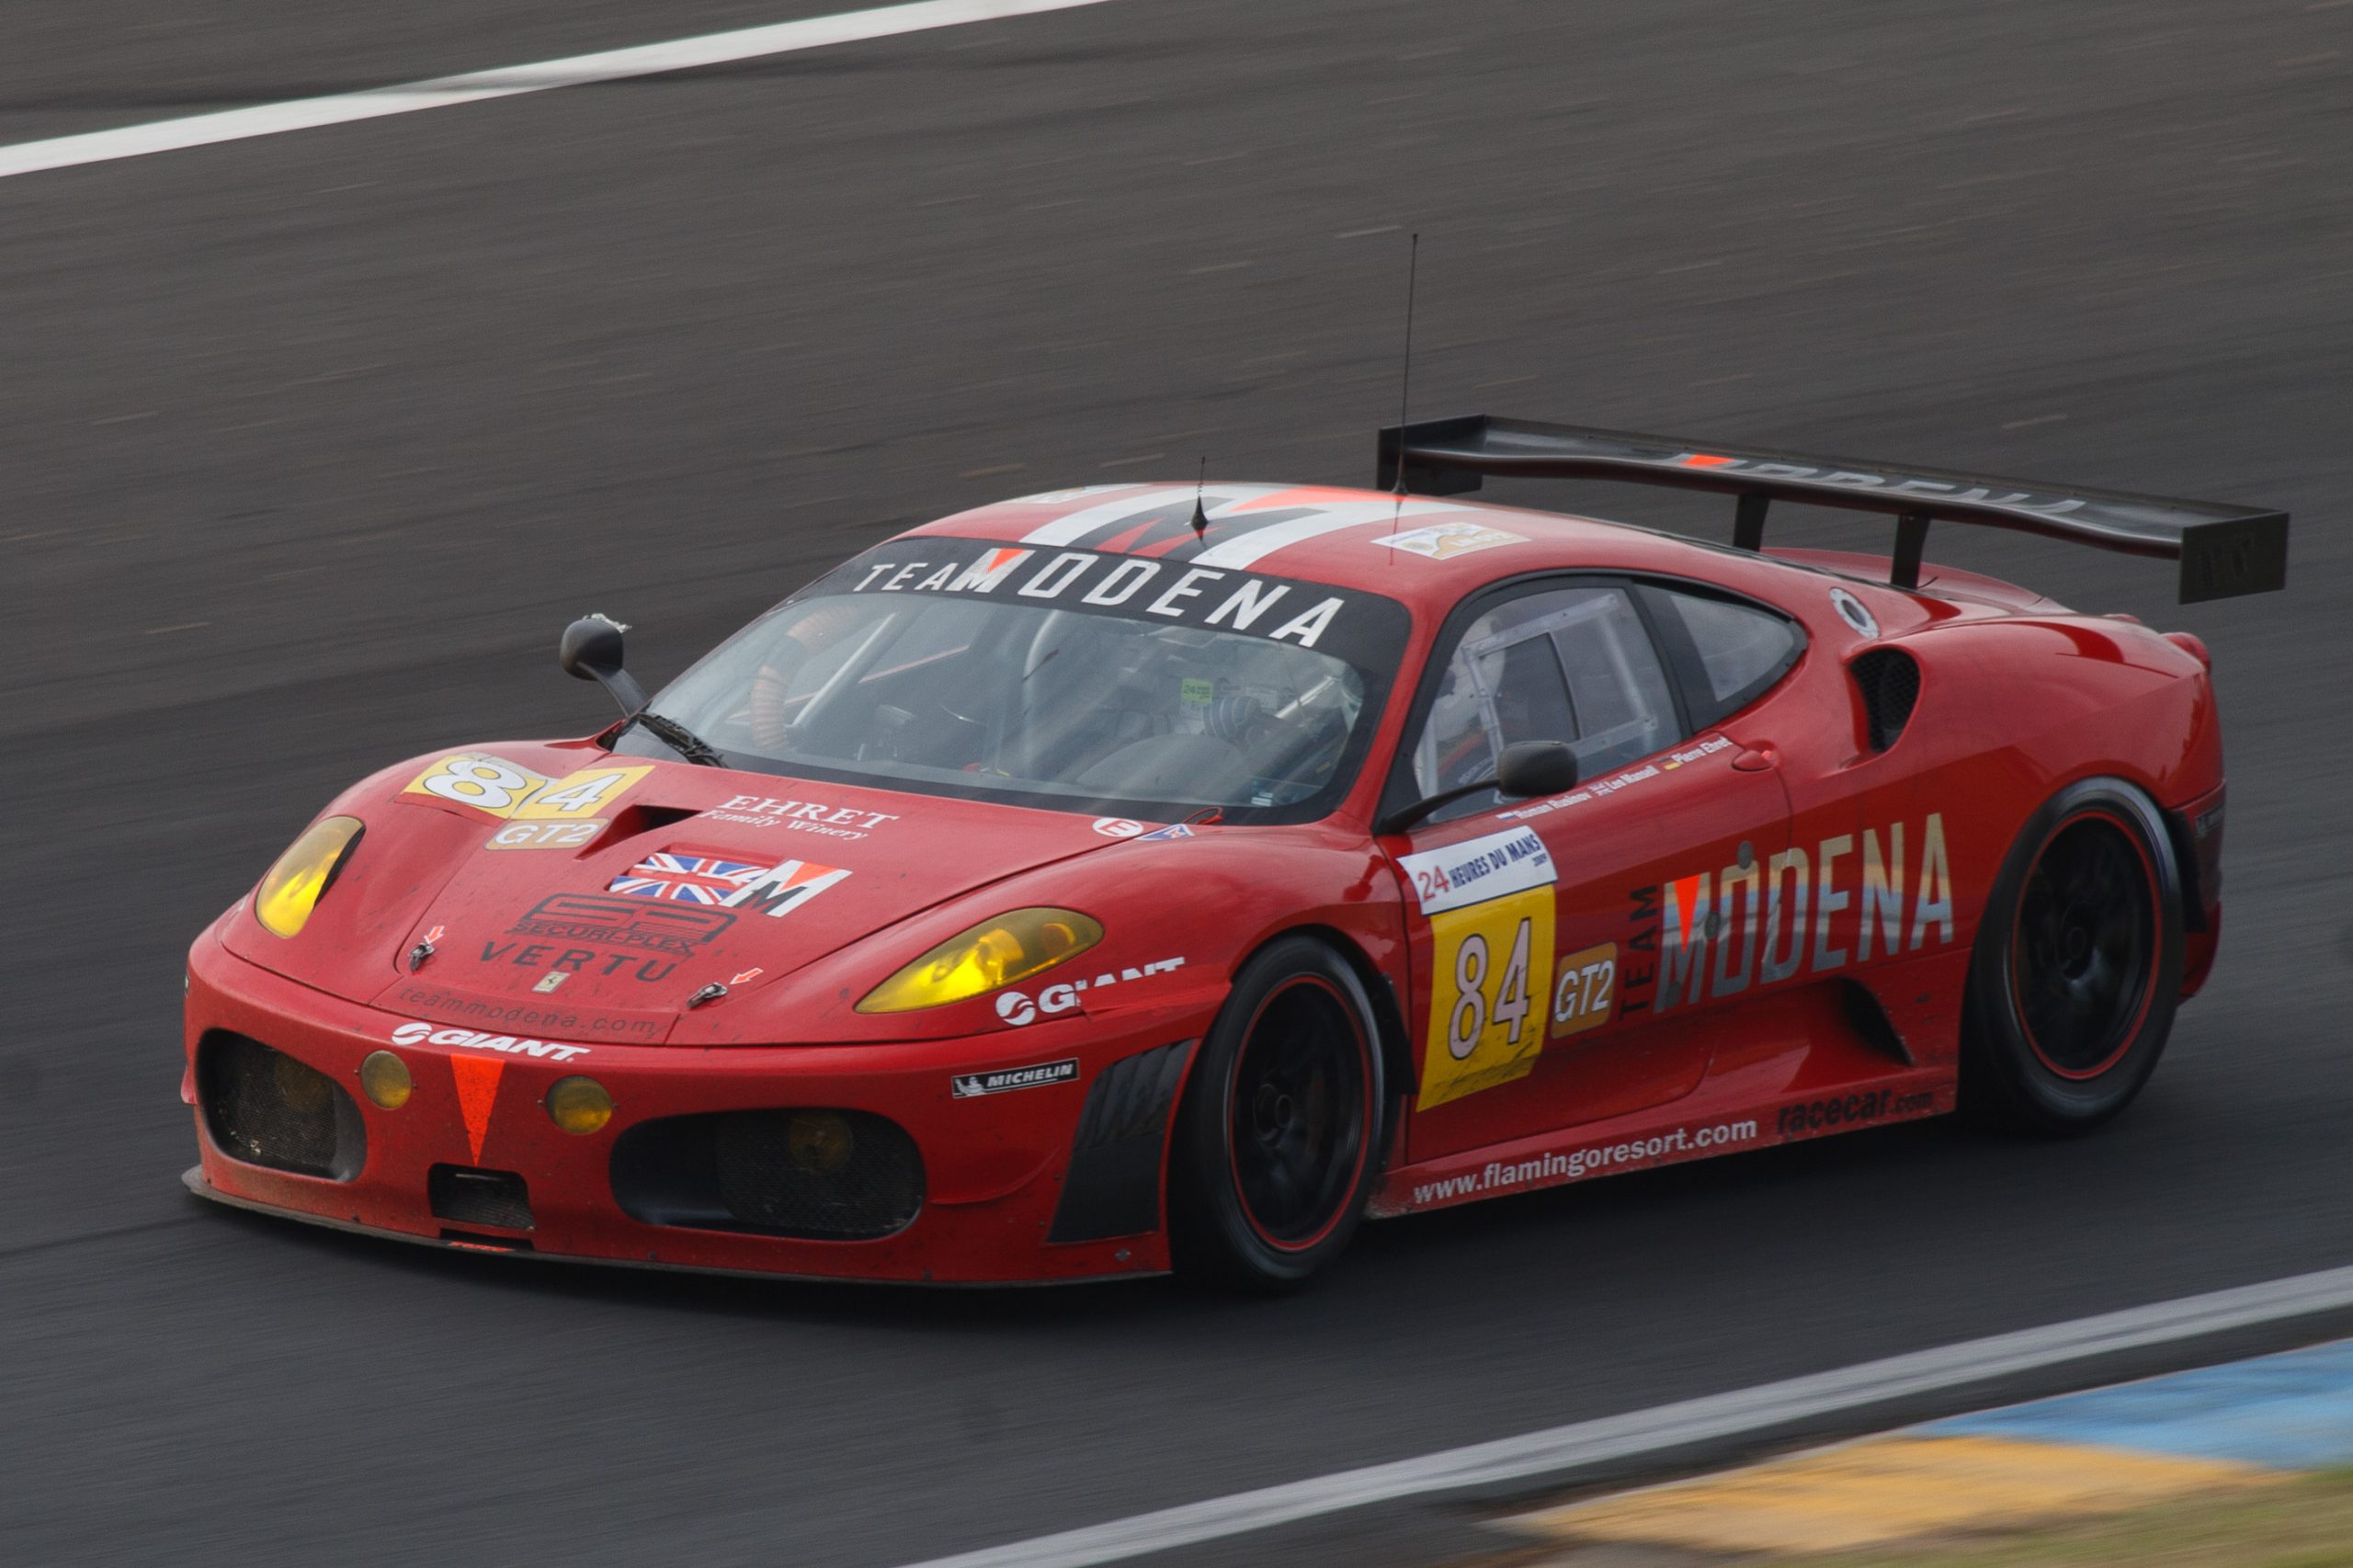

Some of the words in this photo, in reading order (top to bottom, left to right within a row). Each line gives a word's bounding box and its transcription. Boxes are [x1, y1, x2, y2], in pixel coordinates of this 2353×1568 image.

[698, 809, 782, 828] Family
[787, 820, 869, 841] Winery
[716, 794, 901, 829] EHRET
[494, 824, 600, 846] GT2
[1418, 865, 1451, 902] 24
[1448, 855, 1492, 889] HEURES
[1487, 847, 1508, 870] DU
[1505, 833, 1541, 863] MANS
[1618, 884, 1658, 1022] TEAM
[1654, 812, 1955, 1016] MODENA
[479, 940, 679, 983] VERTU
[397, 986, 658, 1036] teammodena.com
[1448, 916, 1531, 1061] 84
[1554, 959, 1616, 1022] GT2
[428, 1028, 592, 1062] GIANT
[986, 1063, 1074, 1088] MICHELIN
[1413, 1119, 1757, 1204] www.flamingoresort.com
